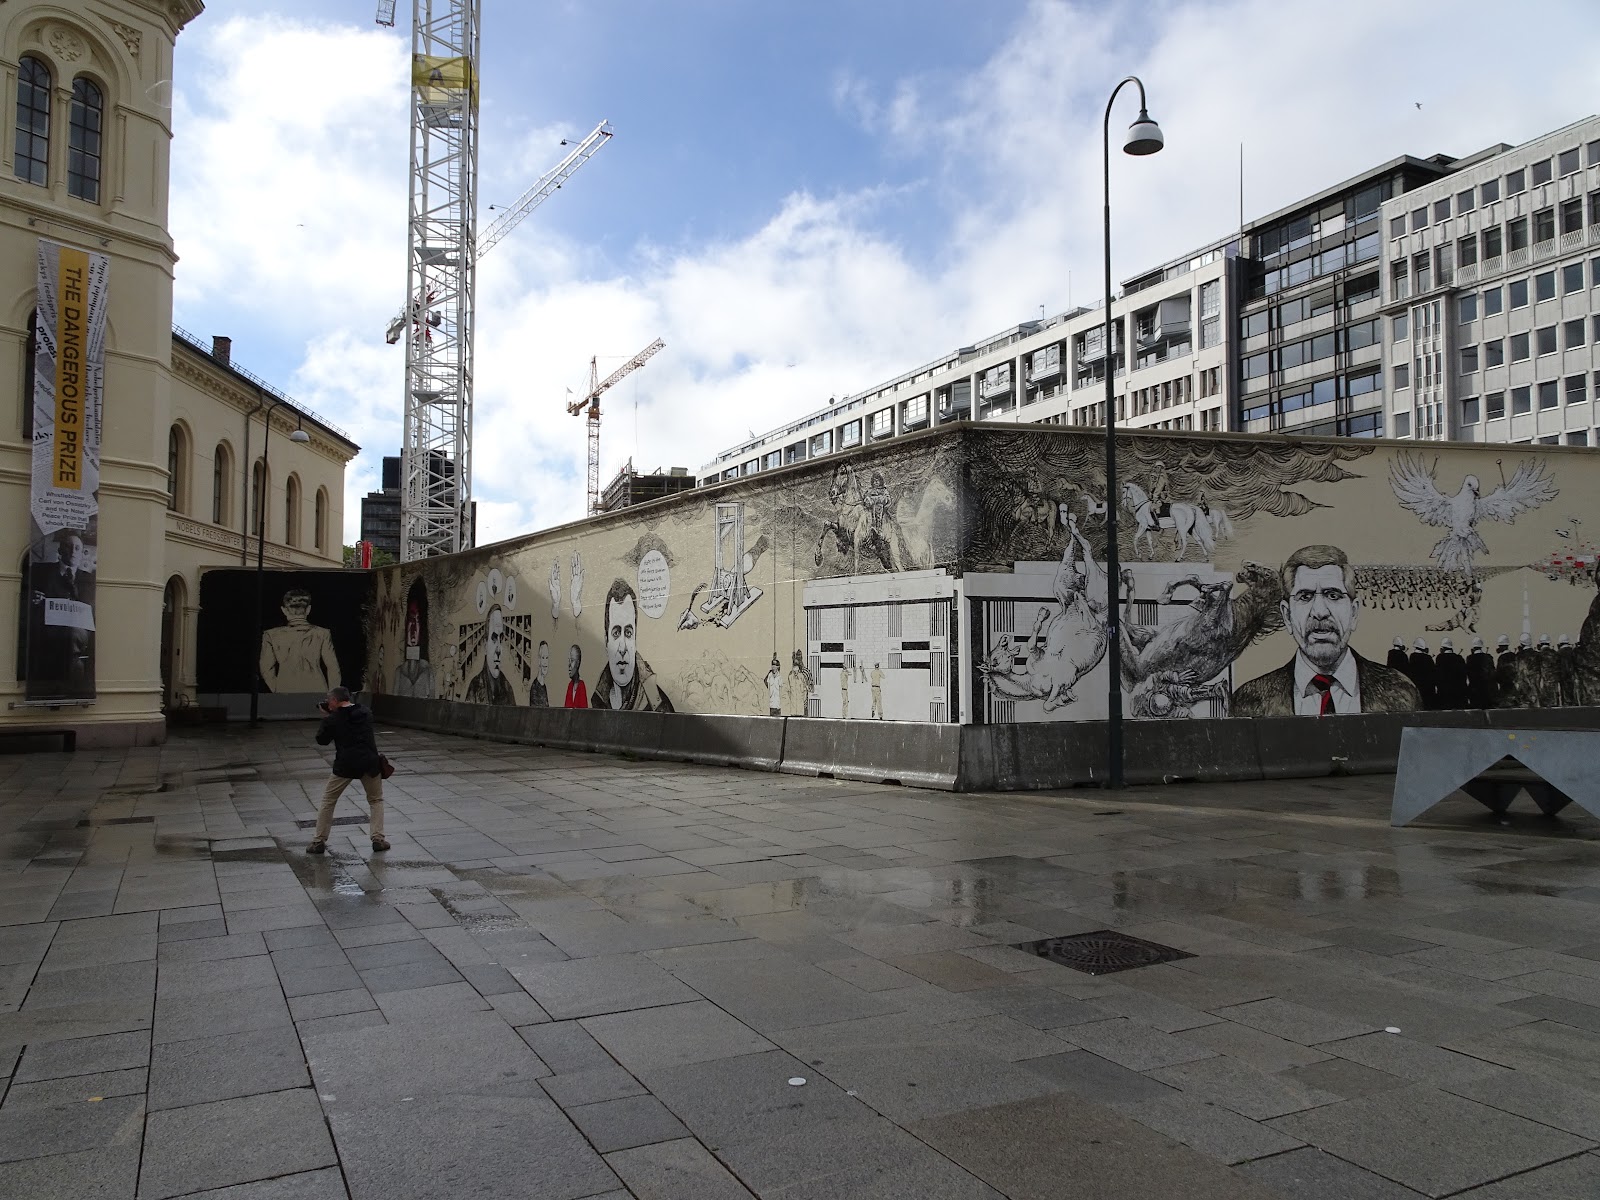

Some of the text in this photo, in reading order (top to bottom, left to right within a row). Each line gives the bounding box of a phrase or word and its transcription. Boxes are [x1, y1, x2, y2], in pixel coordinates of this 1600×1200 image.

[59, 267, 82, 483] THE DANGEROUS PRIZE
[176, 522, 202, 537] NOBELS
[202, 528, 240, 546] FREDSSENTER
